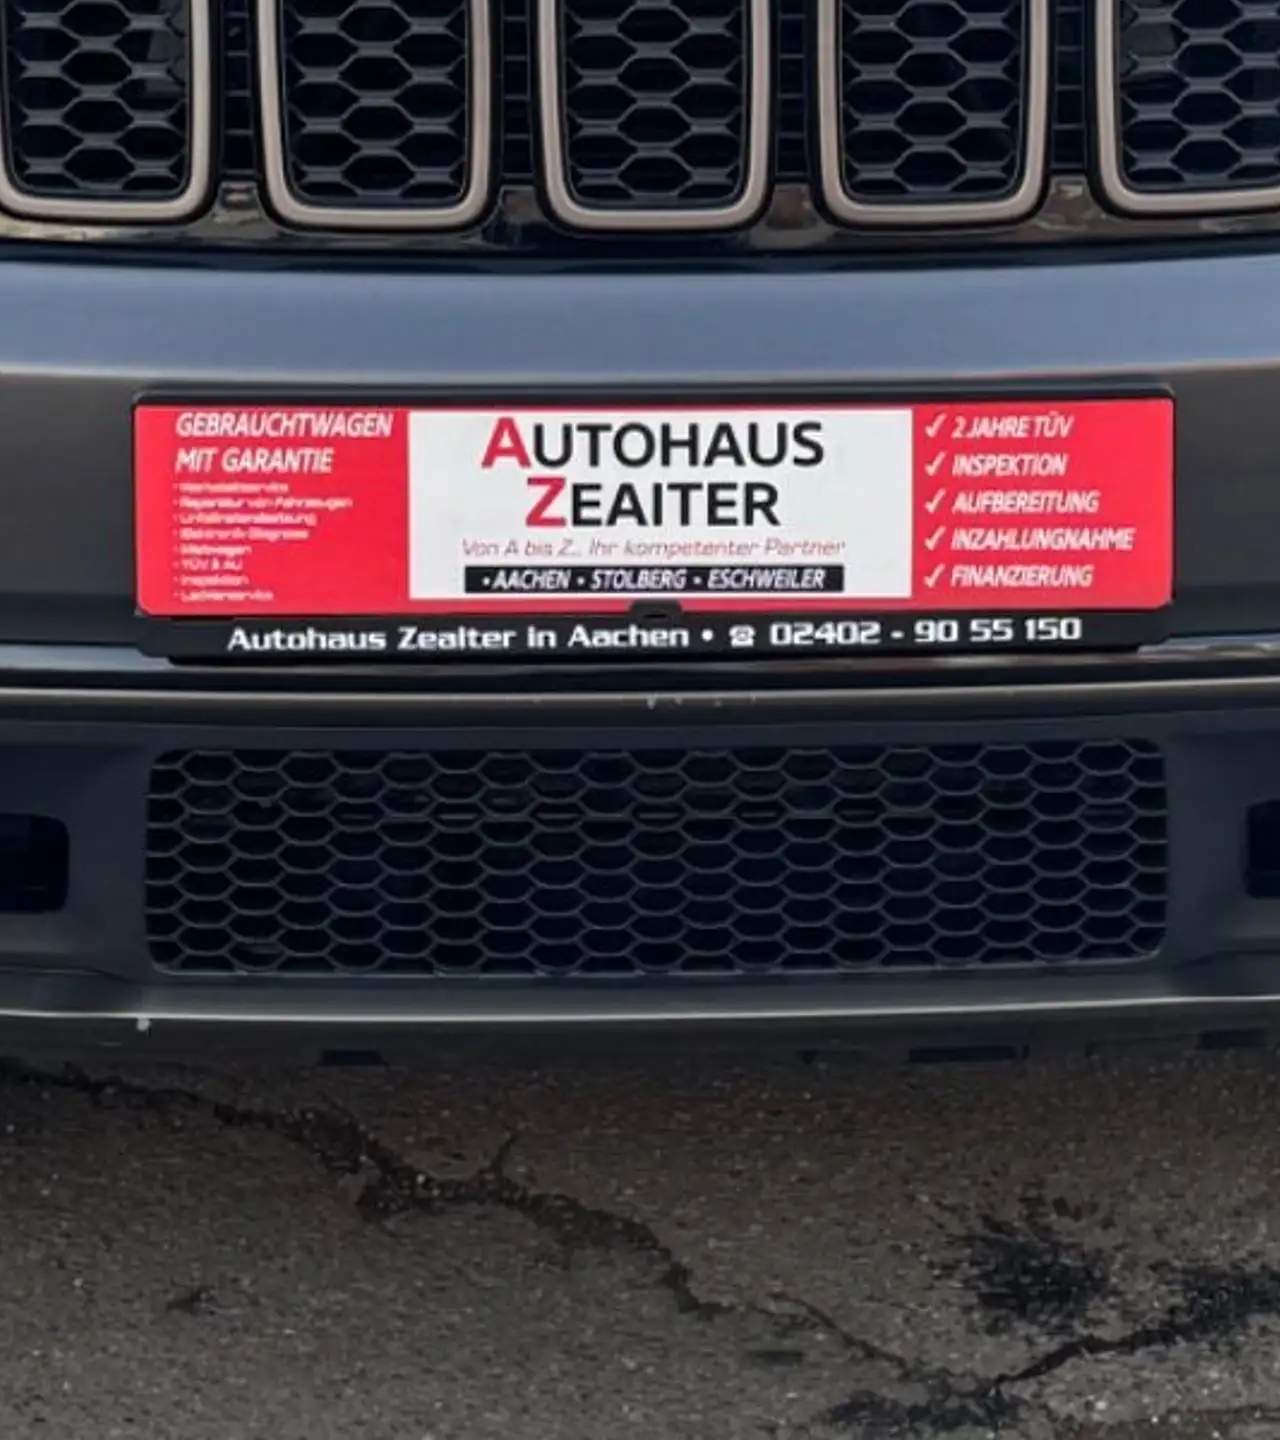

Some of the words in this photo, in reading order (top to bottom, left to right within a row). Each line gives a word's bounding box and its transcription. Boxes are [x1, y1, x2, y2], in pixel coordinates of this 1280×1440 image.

[176, 411, 393, 437] GEBRAUCHTWAGEN
[1034, 411, 1074, 438] TÜV
[482, 417, 823, 469] AUTOHAUS
[175, 448, 217, 473] MIT
[222, 448, 334, 473] GARANTIE
[952, 453, 1068, 476] INSPEKTION
[525, 476, 780, 528] ZEAITER
[952, 490, 1101, 513] AUFBEREITUNG
[462, 539, 500, 556] Von
[504, 539, 519, 556] A
[521, 539, 549, 556] bis
[624, 538, 758, 559] kompetenter
[764, 537, 845, 556] Partner
[951, 528, 1135, 551] INZAHLUNGNAHME
[492, 567, 571, 590] AACHEN
[591, 567, 687, 590] STOLBERG
[707, 567, 826, 589] ESCHWEILER
[950, 565, 1094, 587] FINANZIERUNG
[227, 626, 387, 651] Autohaus
[527, 625, 557, 648] in
[567, 625, 689, 649] Aachen
[770, 621, 880, 645] 02402
[914, 620, 959, 642] 90
[970, 619, 1013, 641] 55
[1025, 617, 1082, 640] 150
